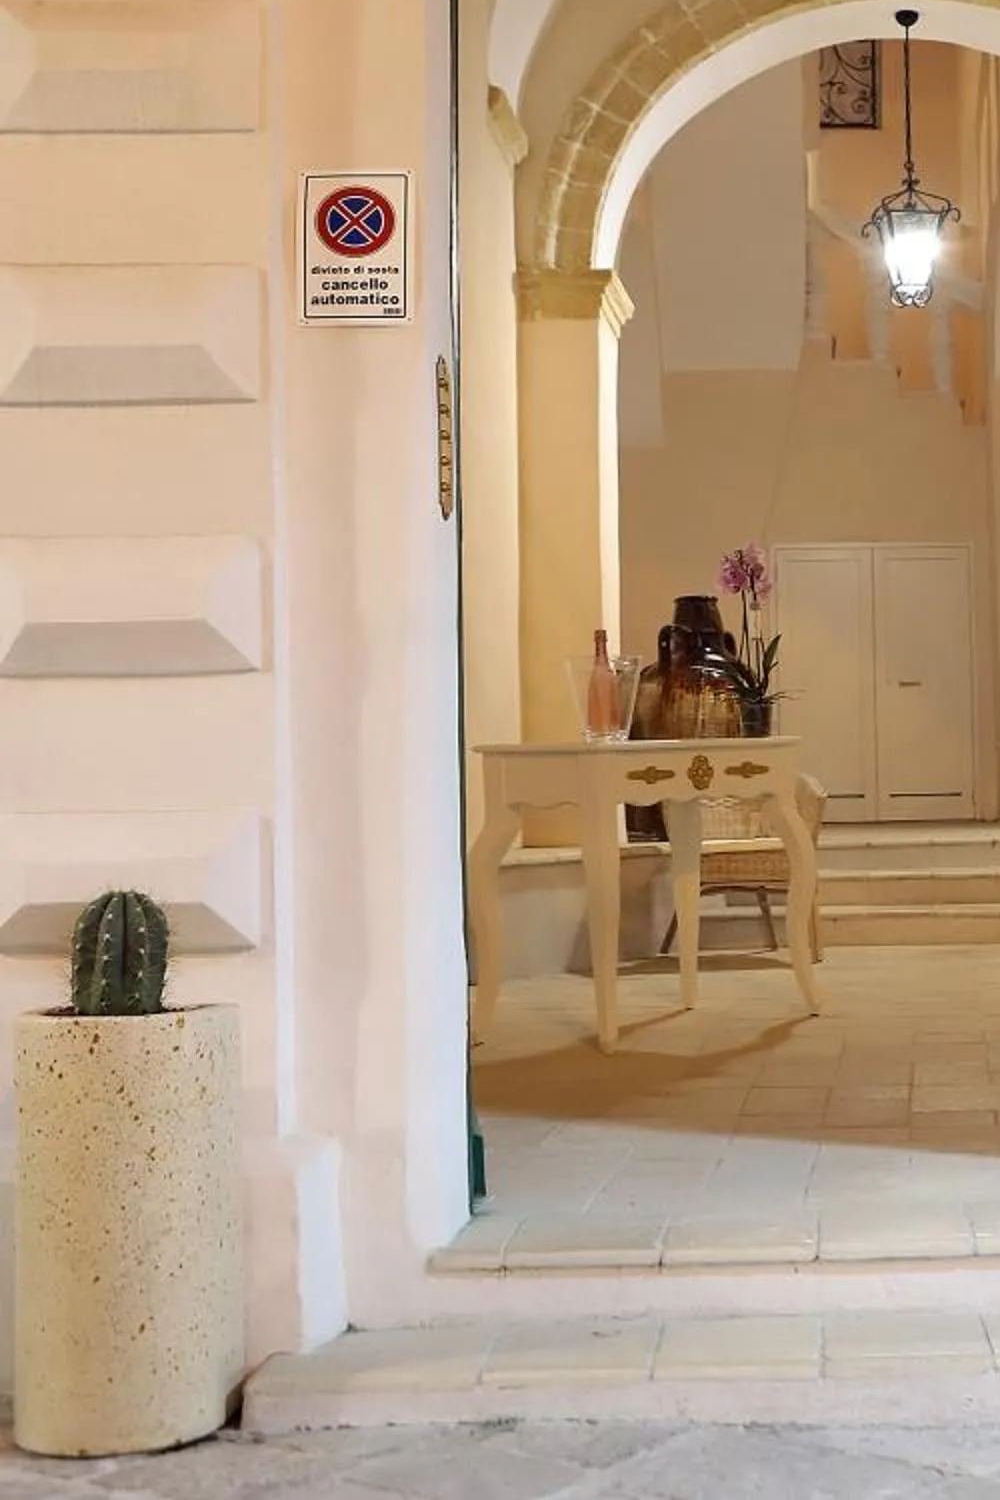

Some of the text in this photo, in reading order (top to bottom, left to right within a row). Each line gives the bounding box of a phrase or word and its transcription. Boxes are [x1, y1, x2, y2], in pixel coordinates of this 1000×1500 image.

[311, 266, 399, 275] divieto di sosta
[321, 278, 389, 290] cancello
[311, 291, 399, 305] automatico
